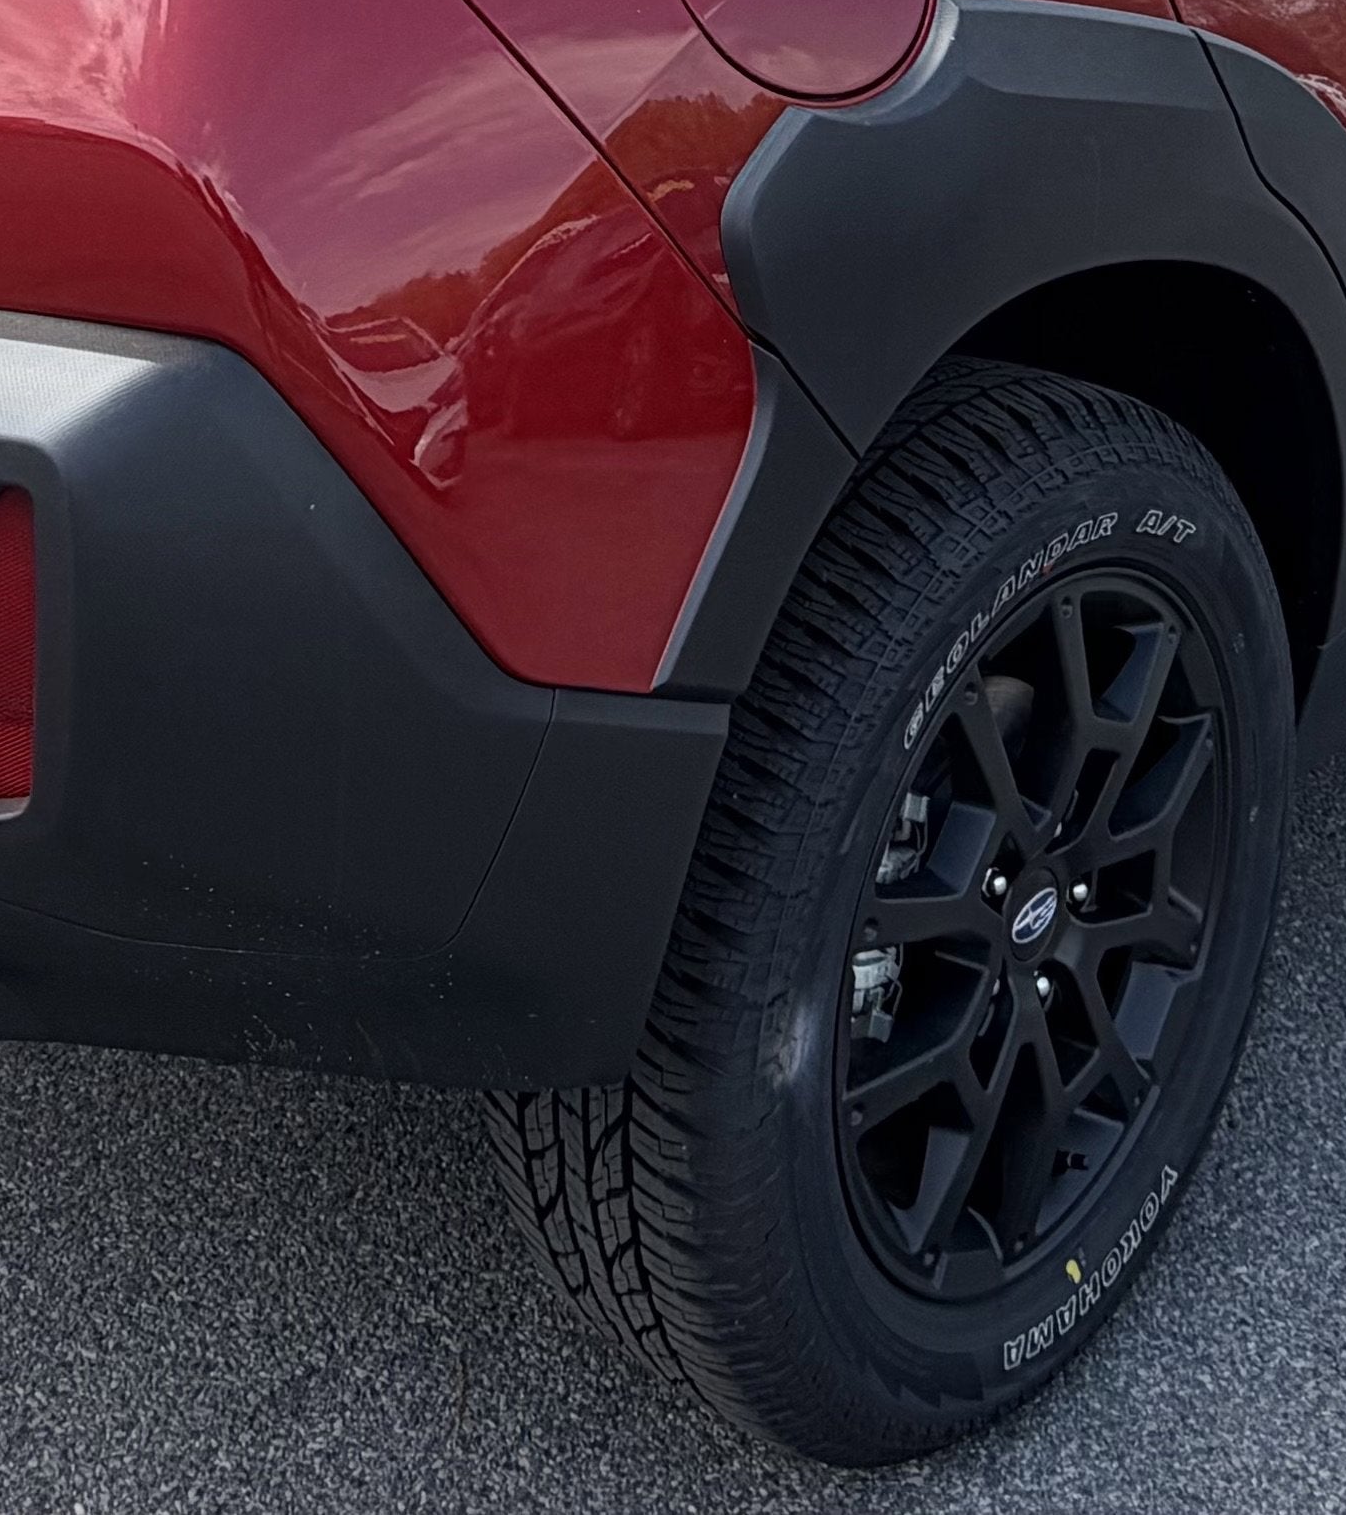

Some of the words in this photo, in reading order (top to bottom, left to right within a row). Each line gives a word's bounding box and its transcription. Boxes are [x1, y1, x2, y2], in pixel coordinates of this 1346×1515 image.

[904, 511, 1119, 750] GEOLANDAR
[1136, 510, 1196, 543] A/T
[1004, 1165, 1179, 1370] YOKOHAMA
